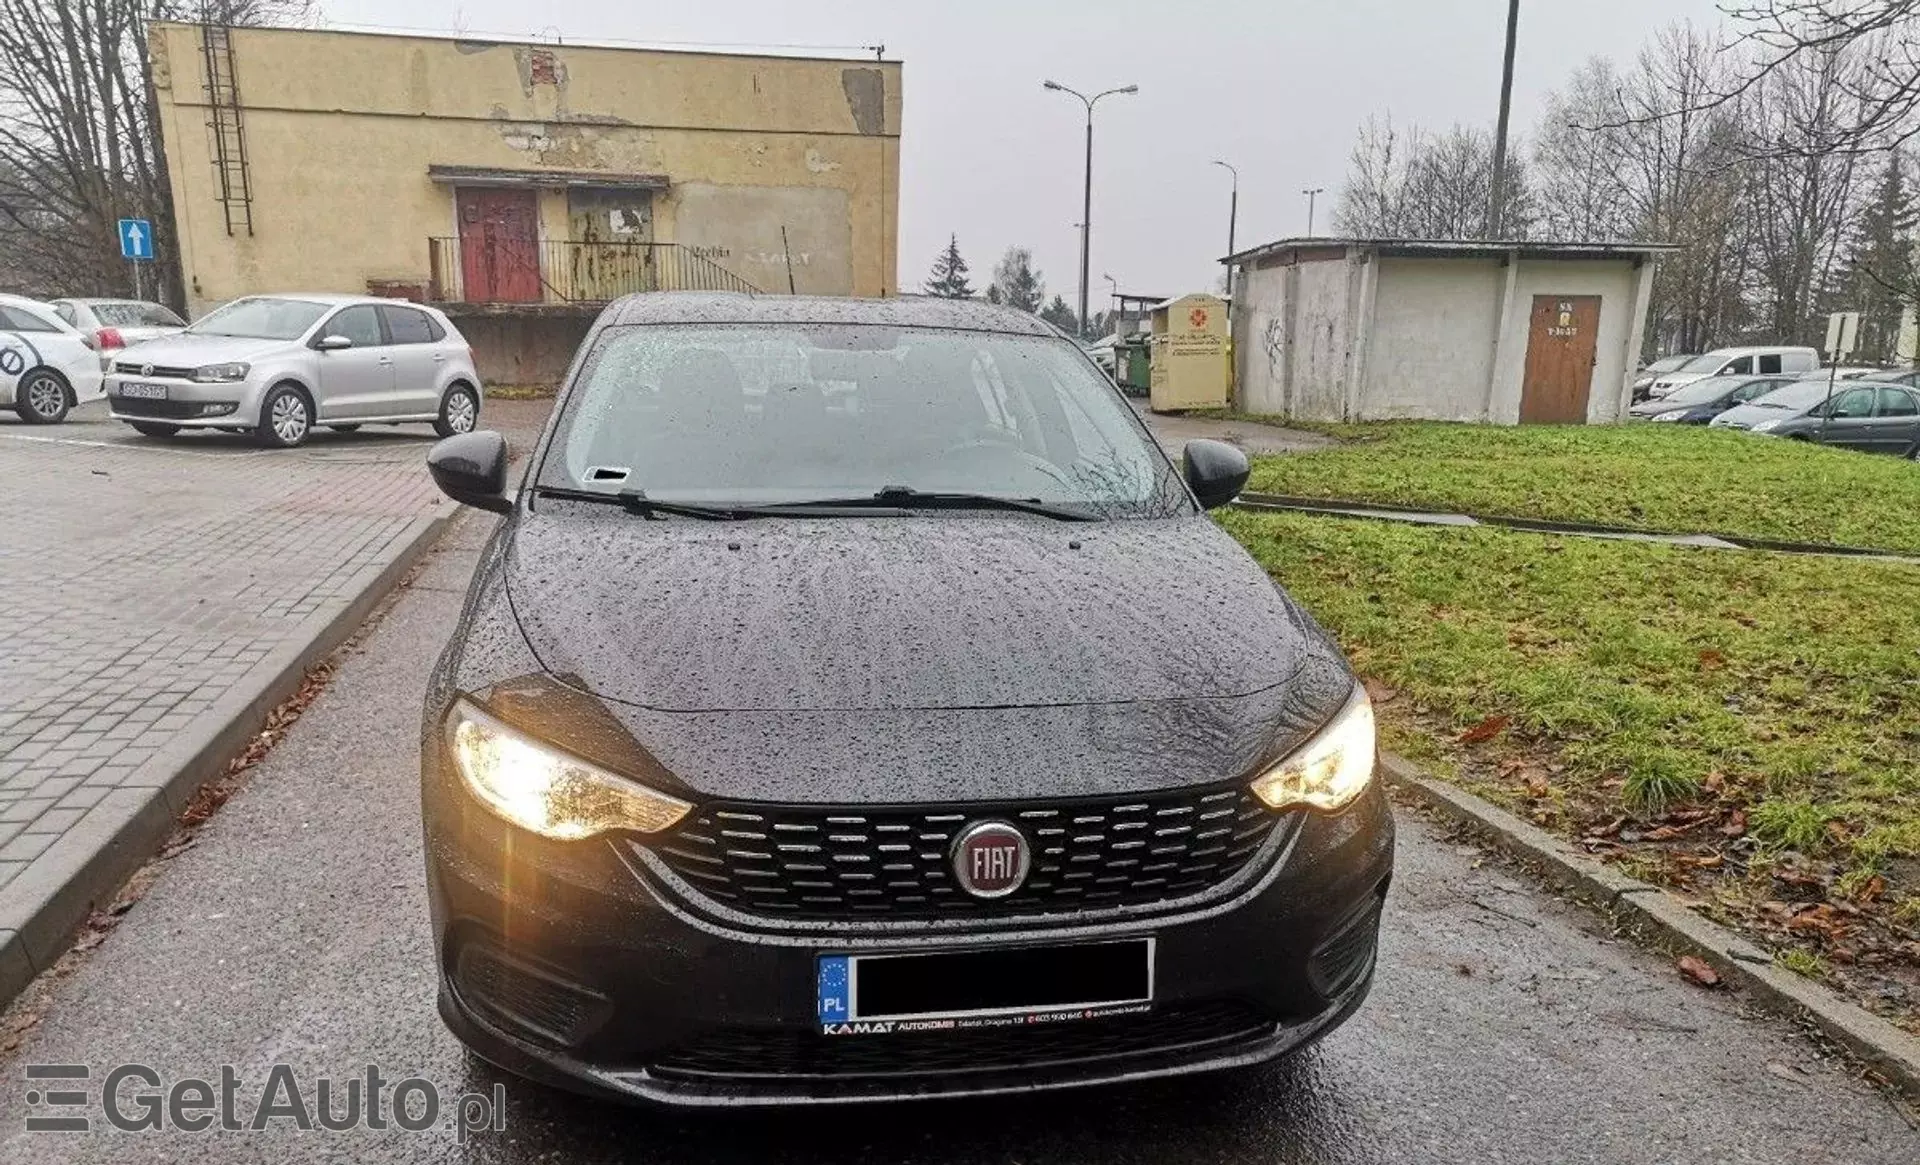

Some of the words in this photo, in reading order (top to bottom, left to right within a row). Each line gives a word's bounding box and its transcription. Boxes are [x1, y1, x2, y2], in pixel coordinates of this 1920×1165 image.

[973, 846, 1016, 880] FIAT
[823, 997, 846, 1013] PL
[823, 1021, 897, 1036] KAMAT
